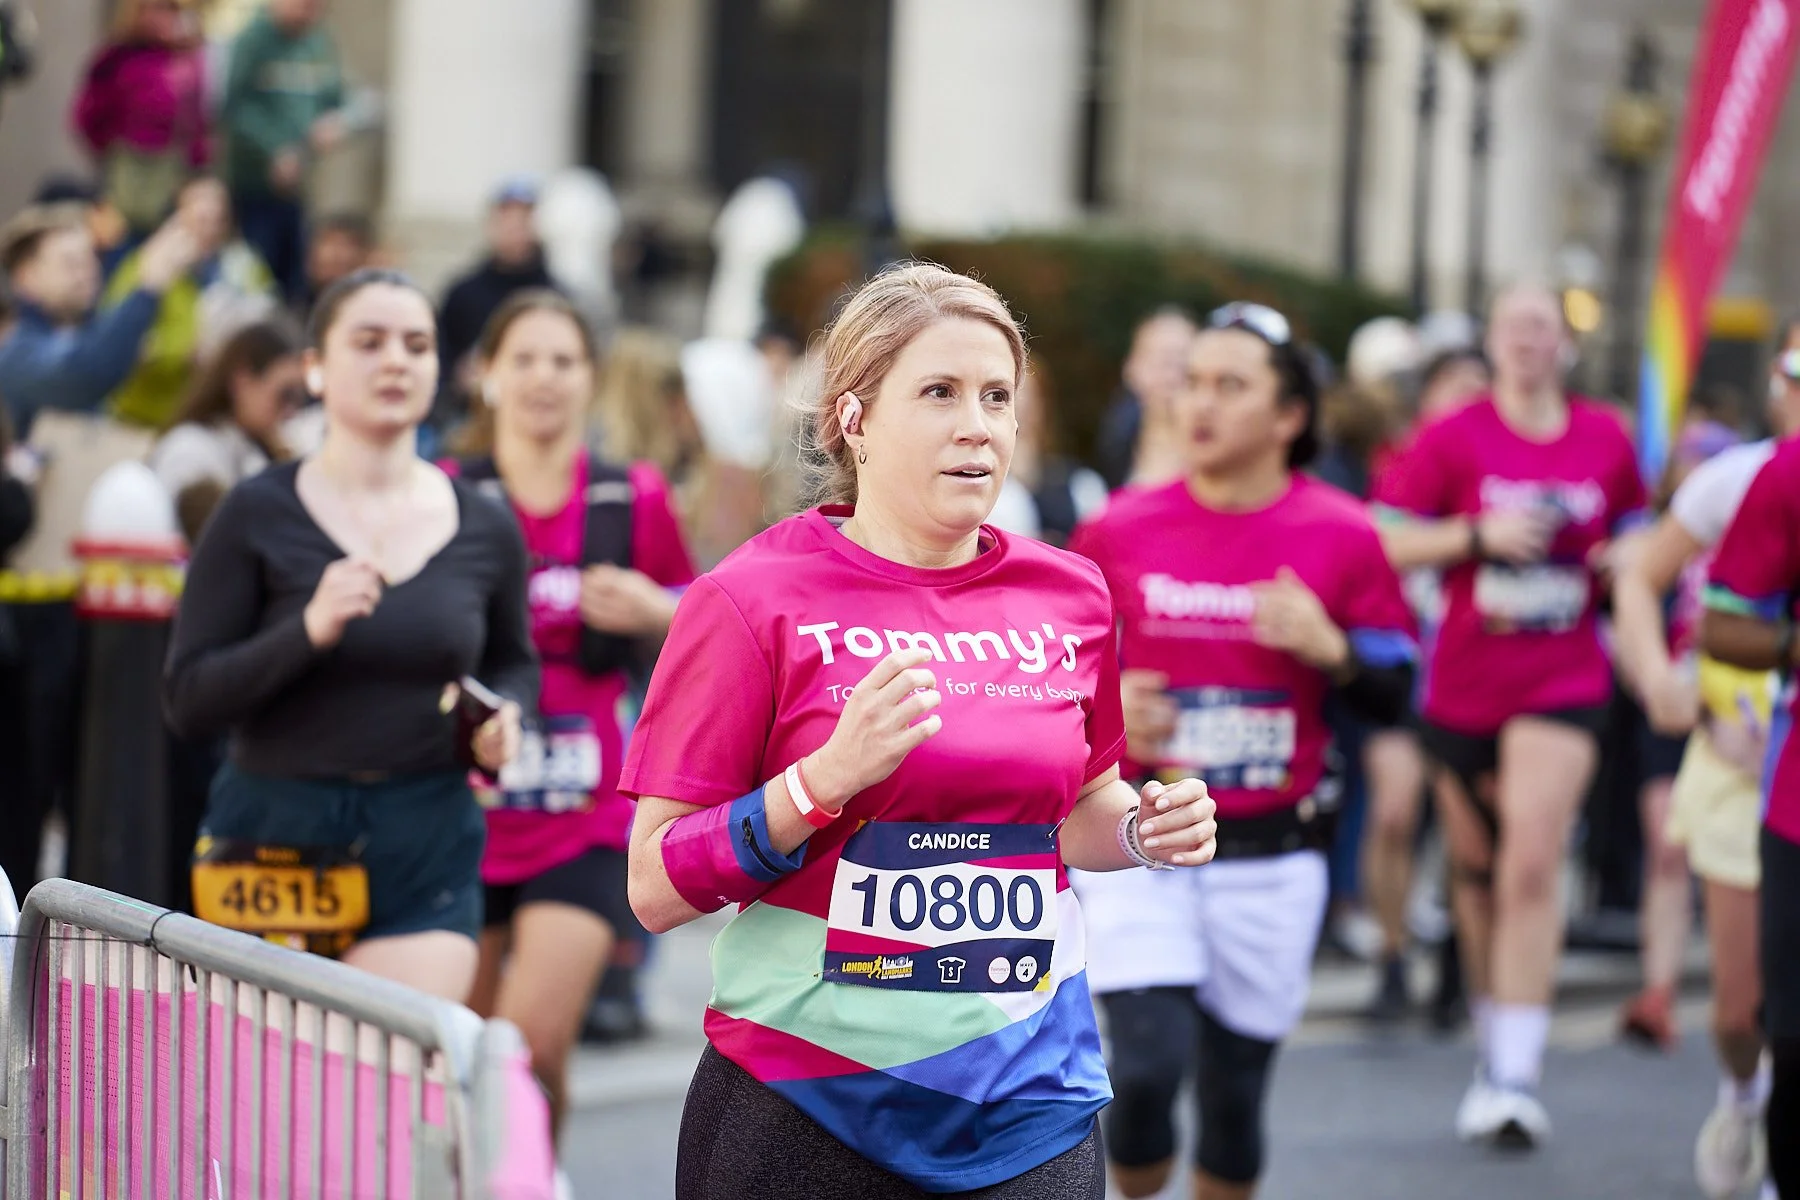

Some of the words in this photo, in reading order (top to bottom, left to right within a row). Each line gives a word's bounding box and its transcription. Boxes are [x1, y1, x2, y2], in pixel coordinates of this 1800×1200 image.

[796, 620, 1083, 674] Tommy's
[946, 678, 978, 696] for
[984, 682, 1044, 701] every
[908, 833, 991, 850] CANDICE
[221, 876, 341, 917] 4615
[851, 874, 1044, 932] 10800
[842, 961, 873, 973] LONDON
[948, 966, 954, 978] S
[1022, 968, 1029, 978] 4
